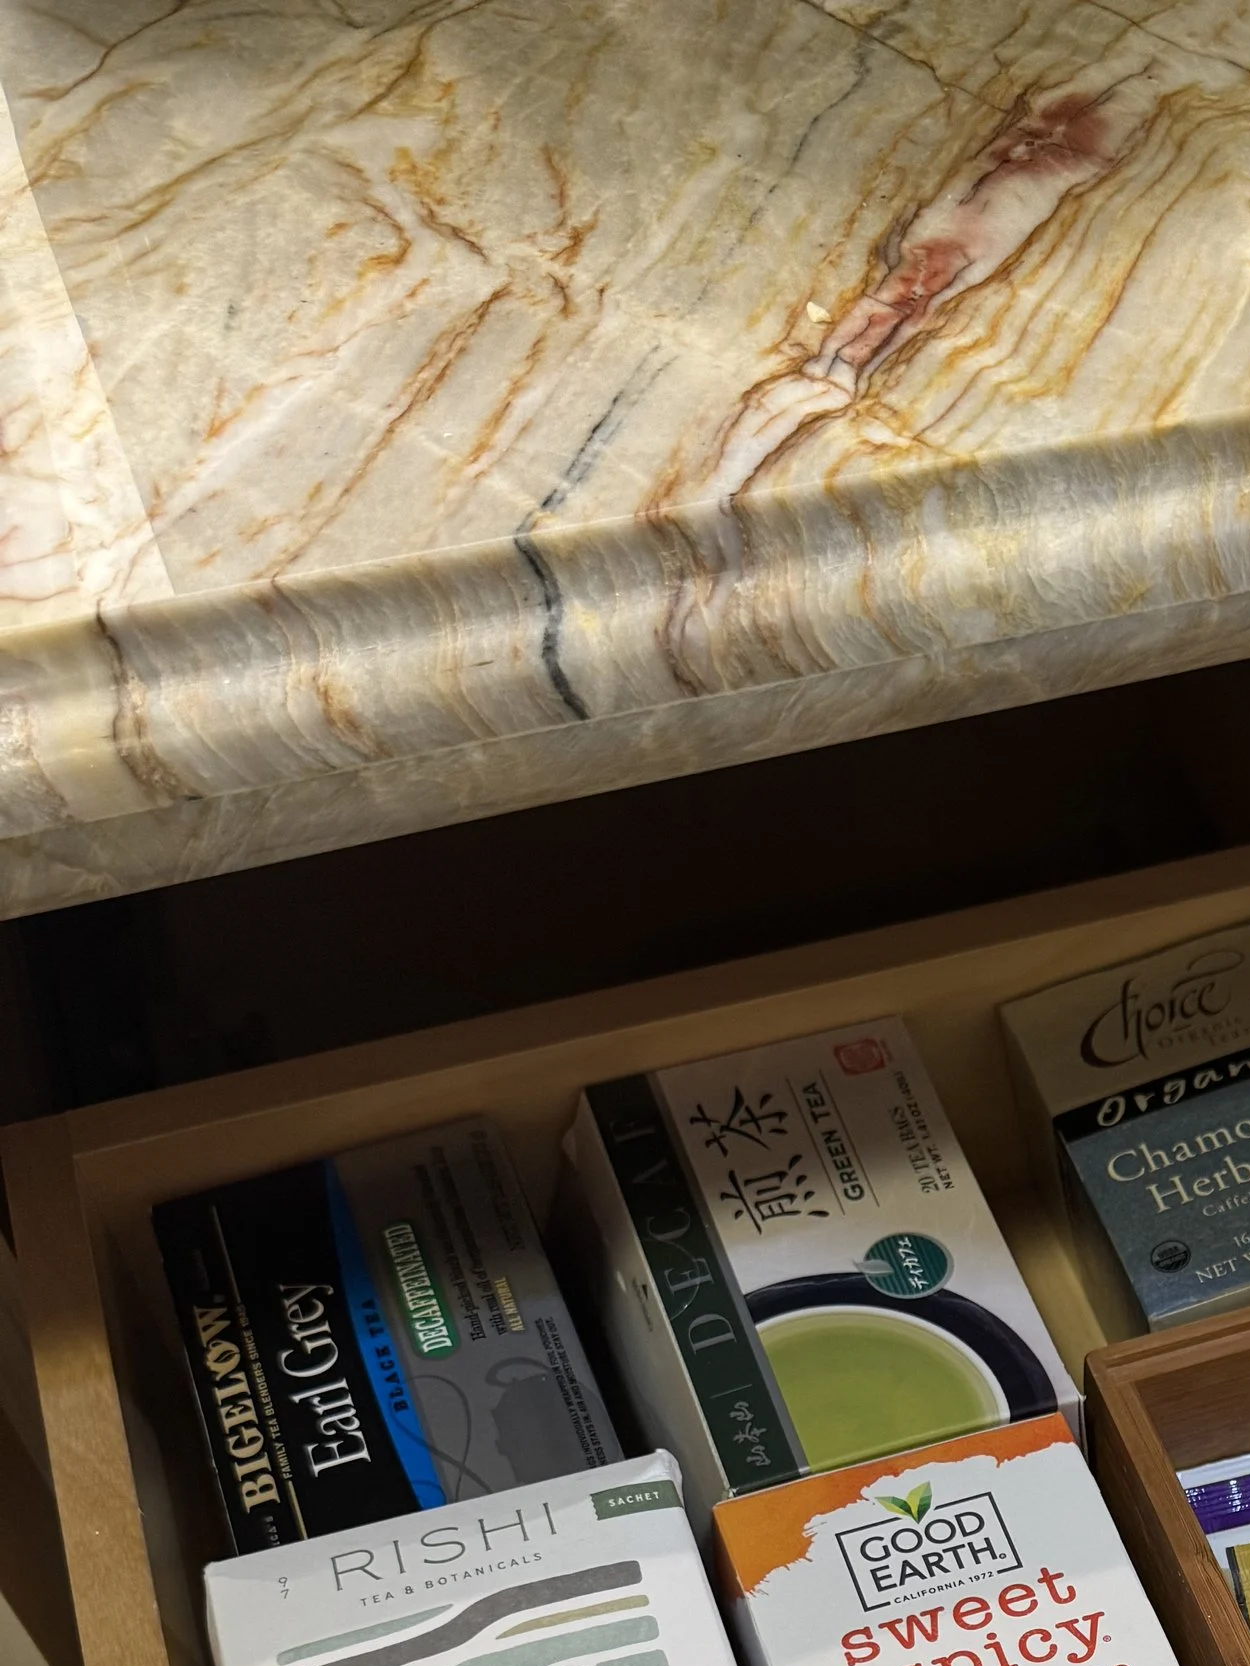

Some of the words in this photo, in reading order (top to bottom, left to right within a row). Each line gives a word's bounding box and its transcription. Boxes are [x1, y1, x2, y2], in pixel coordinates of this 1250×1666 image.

[803, 1082, 831, 1122] TEA
[822, 1130, 865, 1201] GREEN
[611, 1116, 738, 1356] DECAF
[384, 1223, 453, 1354] DECAFFEINATED
[1196, 1259, 1236, 1285] NET
[278, 1282, 345, 1379] Grey
[361, 1298, 384, 1337] TEA
[193, 1305, 281, 1514] BIGELOW
[374, 1346, 407, 1413] BLACK
[290, 1378, 372, 1478] Earl
[608, 1490, 661, 1508] SACHET
[330, 1501, 559, 1593] RISHI
[859, 1512, 986, 1564] GOOD
[359, 1590, 395, 1608] TEA
[404, 1584, 416, 1596] &
[425, 1552, 545, 1590] BOTANICALS
[893, 1577, 966, 1604] CALIFORNIA
[968, 1570, 995, 1584] 1972
[841, 1565, 1077, 1666] sweet
